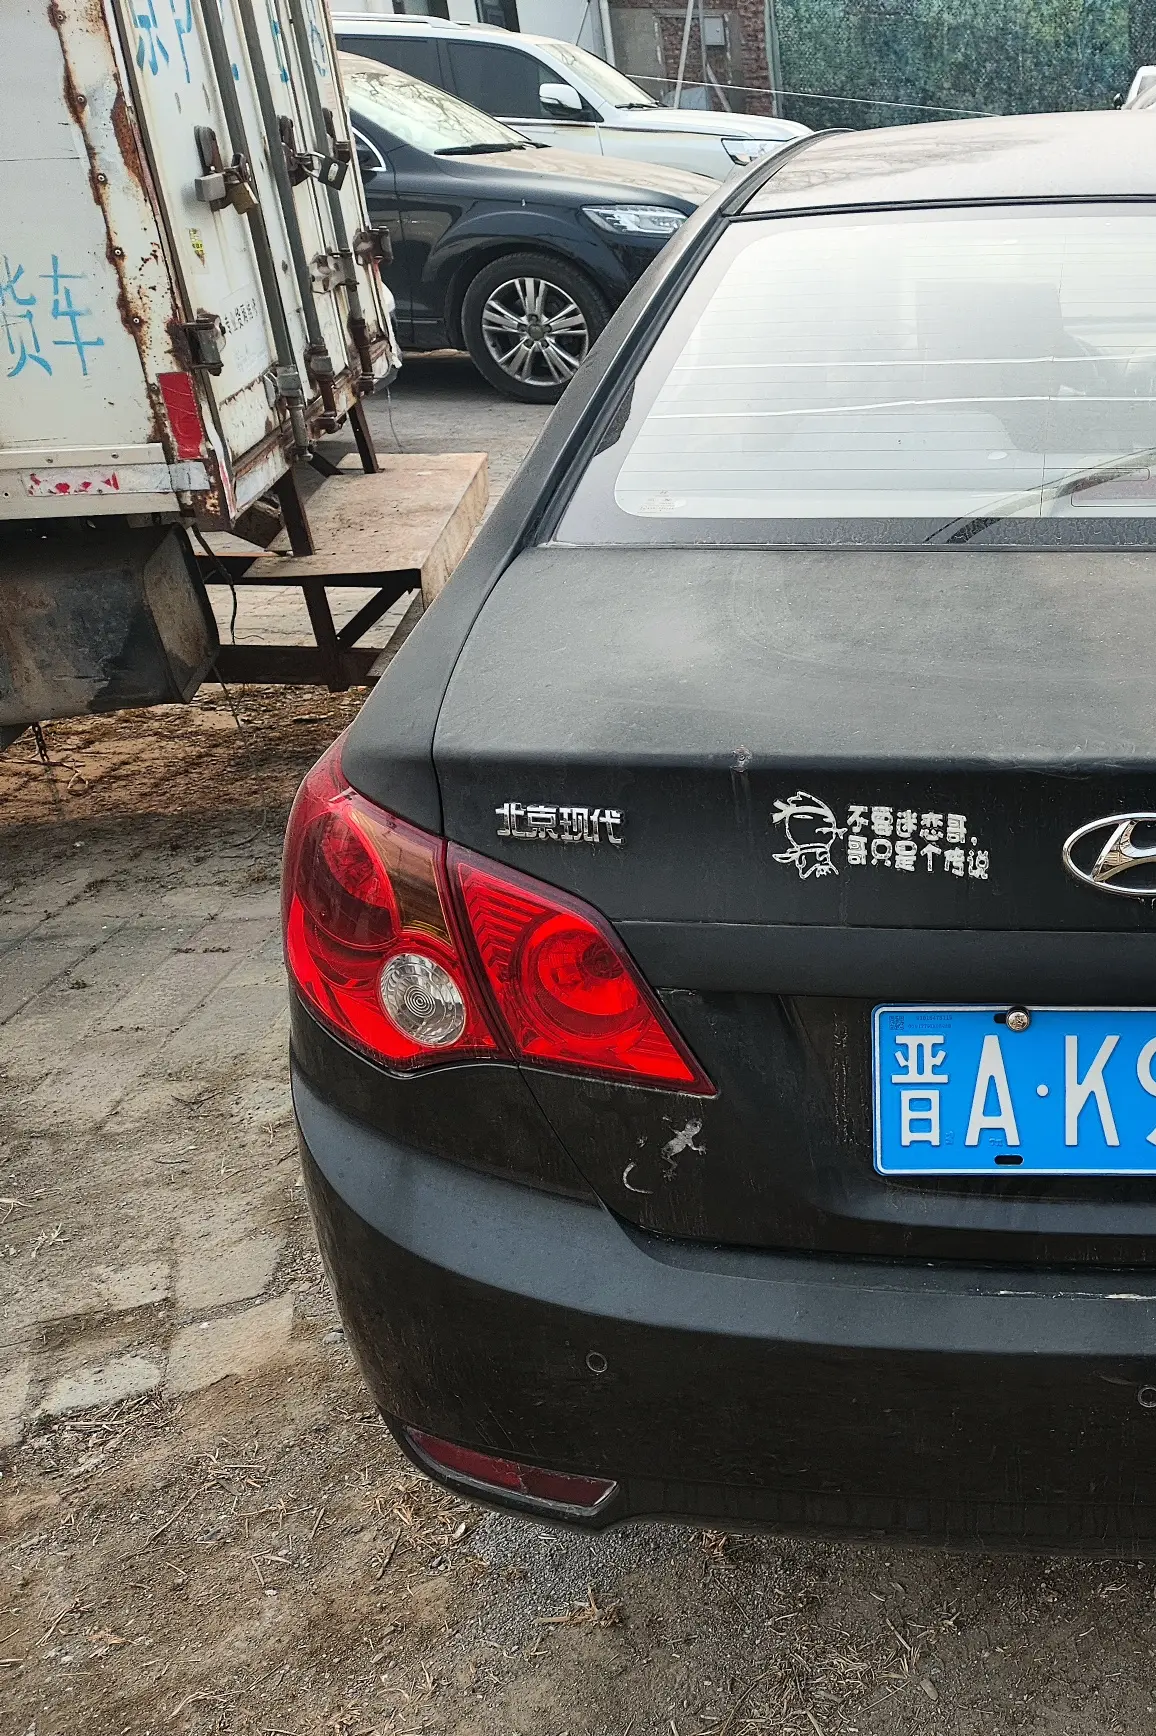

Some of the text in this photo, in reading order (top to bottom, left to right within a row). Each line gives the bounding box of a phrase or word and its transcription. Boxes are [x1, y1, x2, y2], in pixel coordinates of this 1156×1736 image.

[495, 802, 625, 845] 北京现代
[847, 834, 989, 880] 哥只是个传说
